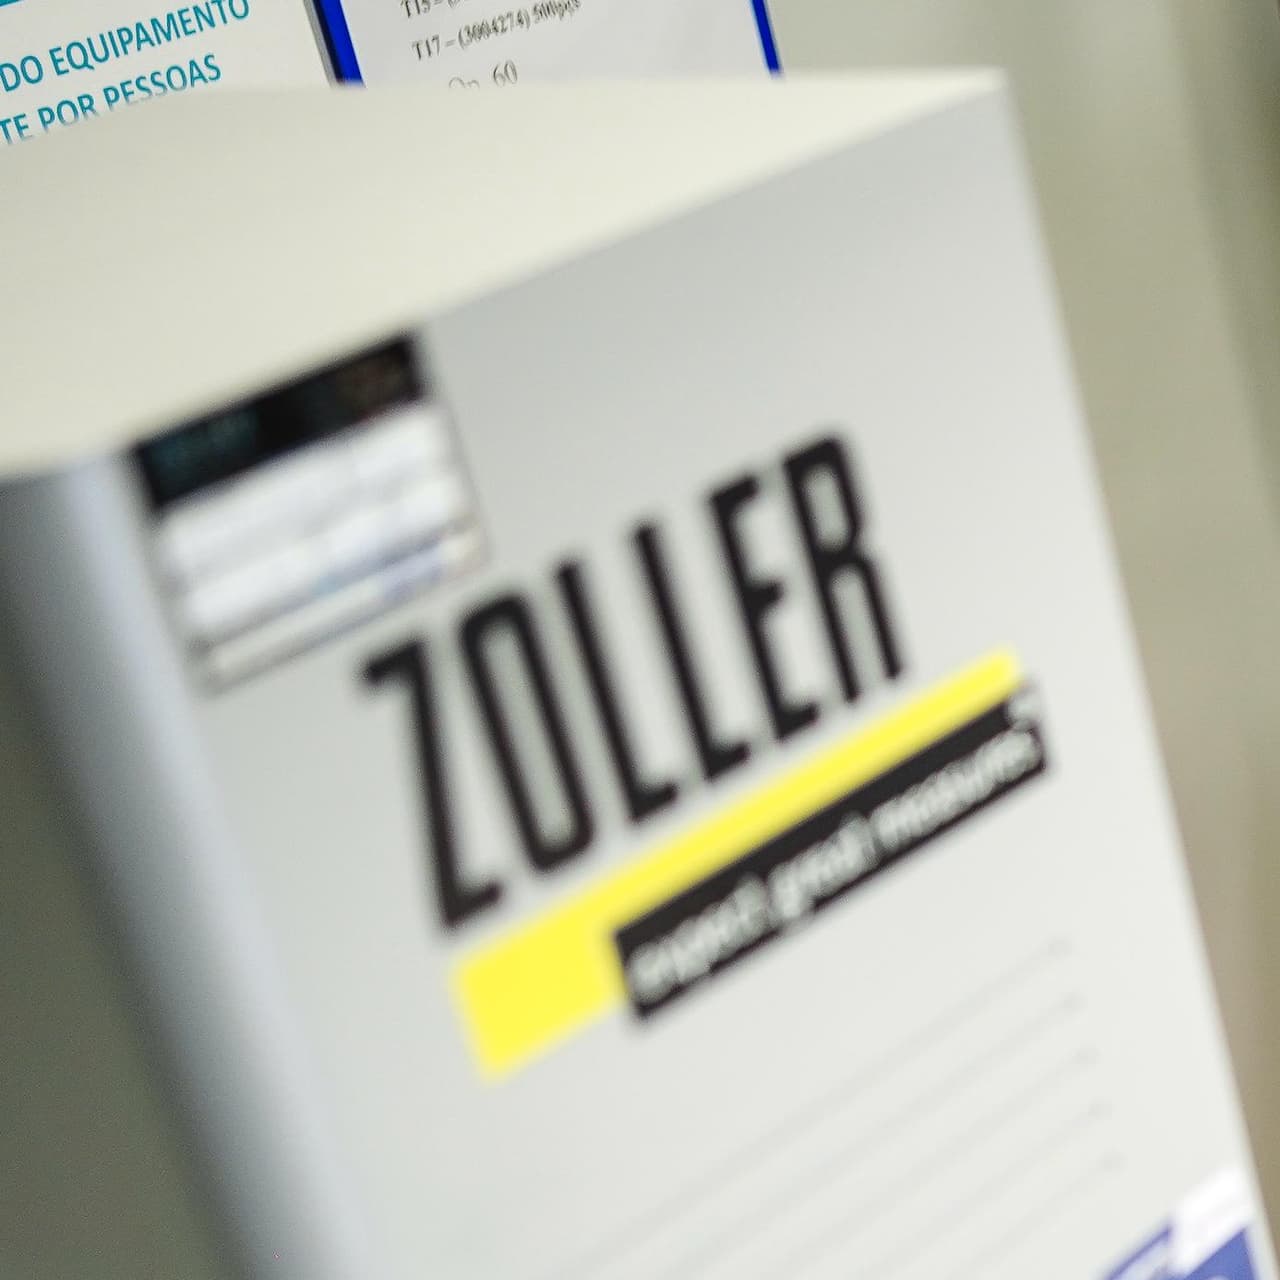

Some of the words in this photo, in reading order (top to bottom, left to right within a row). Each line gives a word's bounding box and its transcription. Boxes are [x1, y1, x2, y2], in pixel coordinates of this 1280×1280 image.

[0, 55, 44, 92] DO
[49, 0, 250, 76] EQUIPAMENTO
[411, 34, 441, 61] T17
[493, 59, 518, 87] 60
[37, 94, 101, 132] POR
[103, 54, 222, 112] PESSOAS
[361, 430, 904, 930] ZOLLER
